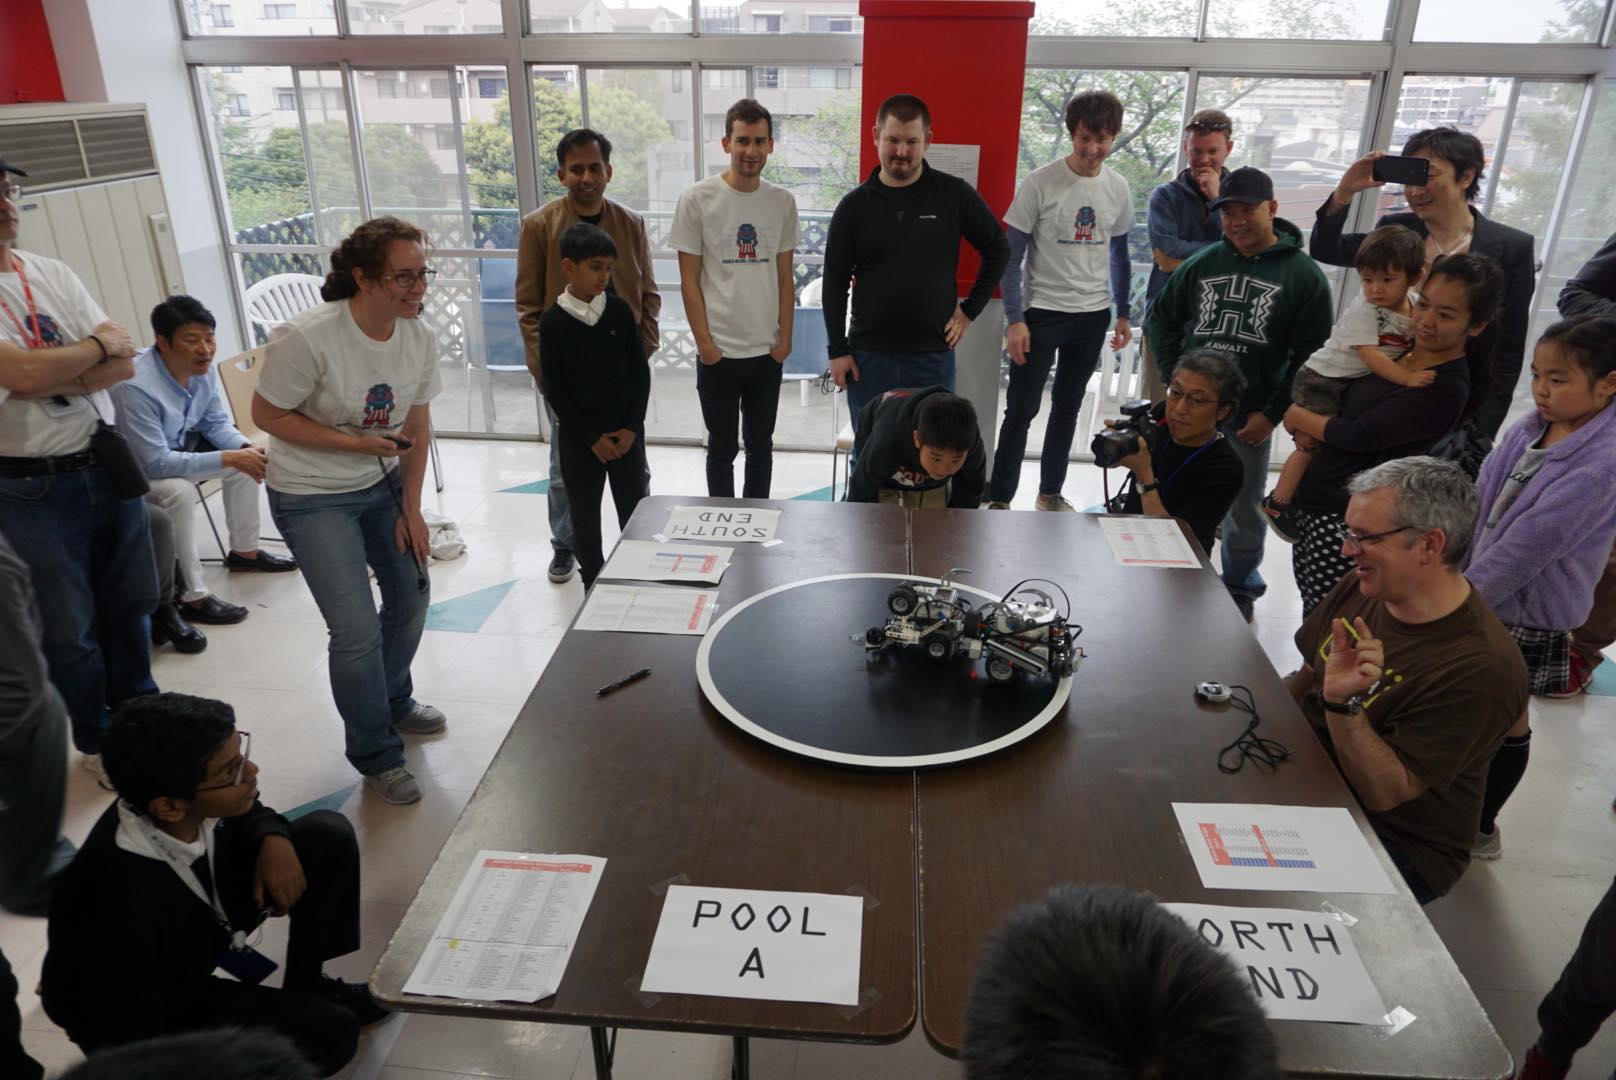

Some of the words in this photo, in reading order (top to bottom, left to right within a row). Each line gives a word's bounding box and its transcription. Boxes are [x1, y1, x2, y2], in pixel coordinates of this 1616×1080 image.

[1194, 274, 1282, 344] H
[671, 524, 768, 538] SOUTH
[698, 511, 753, 524] END
[692, 899, 827, 937] POOL
[1197, 918, 1342, 956] ORTH
[738, 947, 765, 979] A
[1246, 965, 1319, 1001] ND
